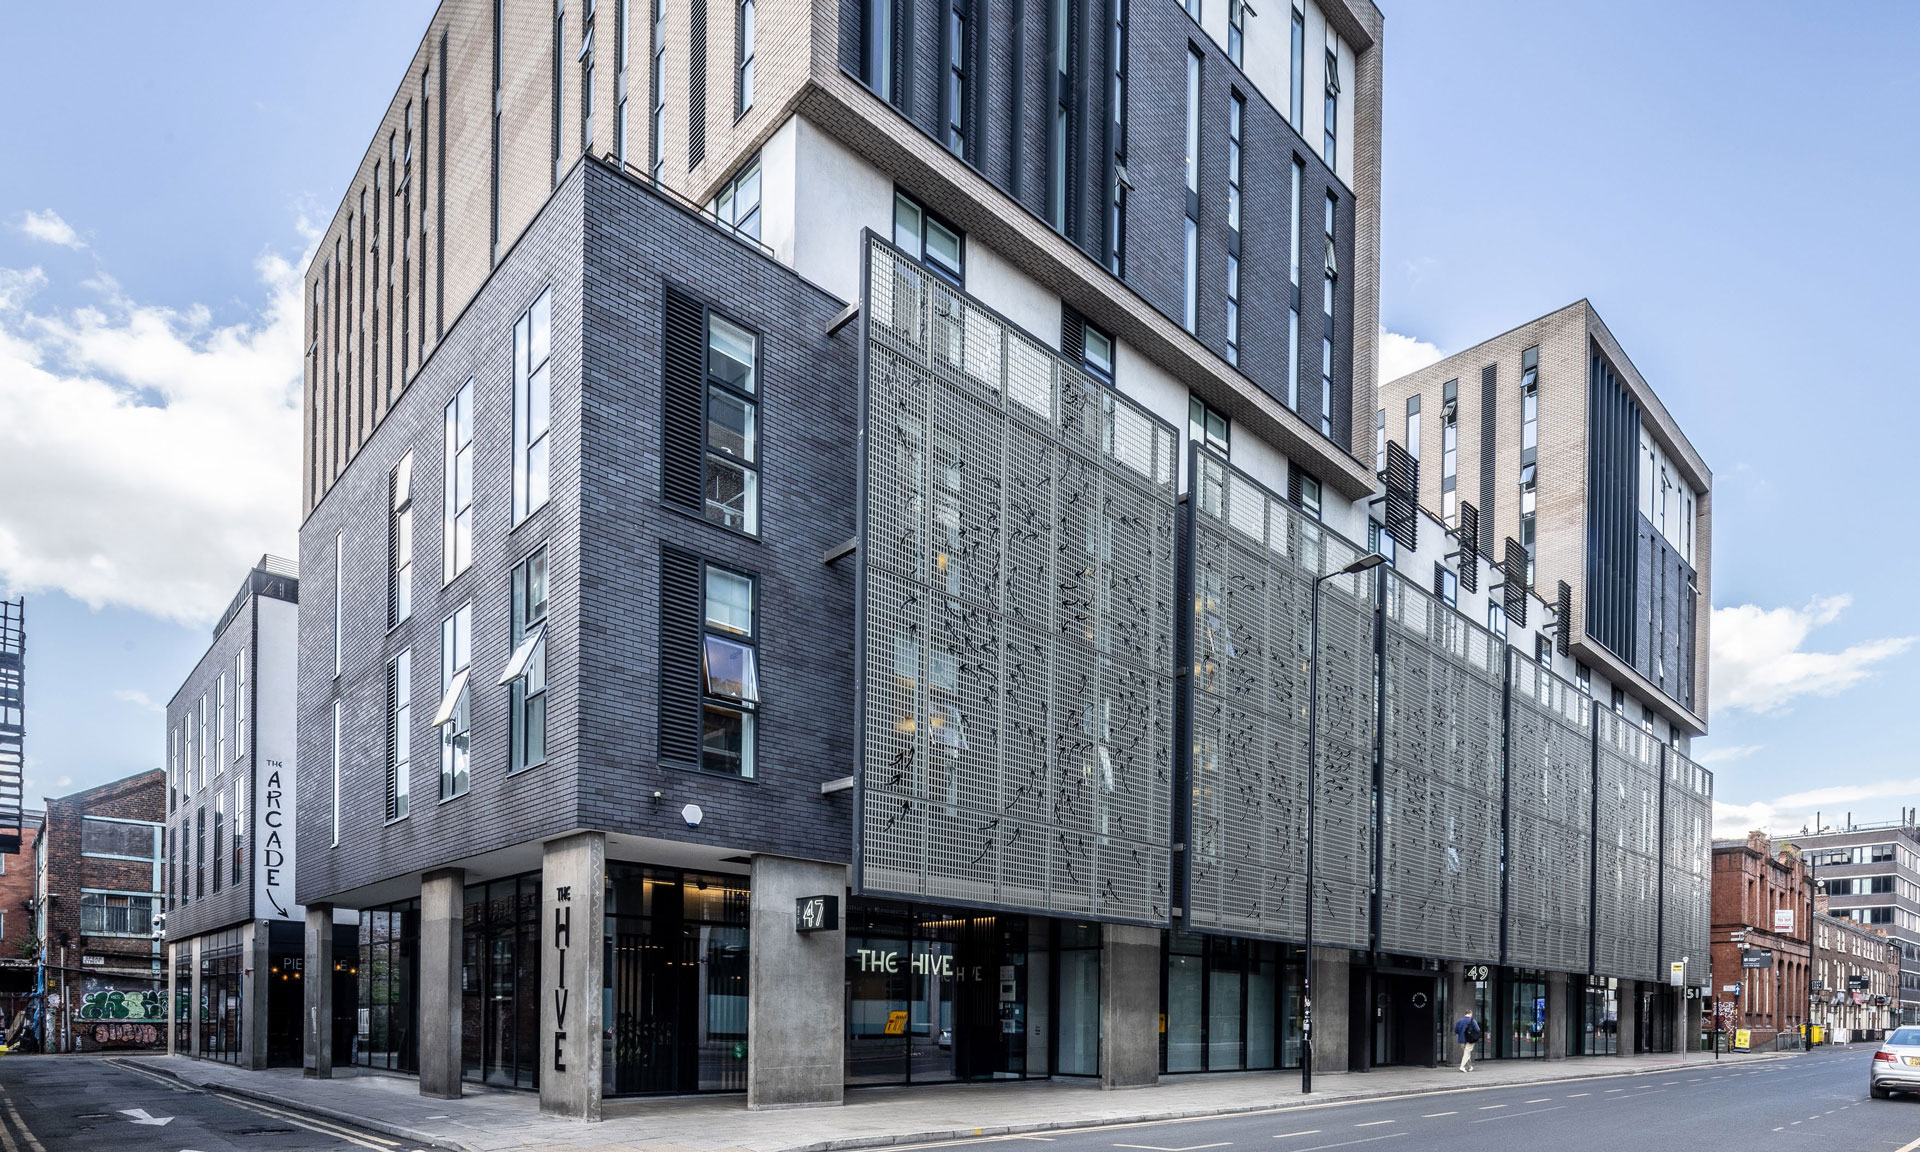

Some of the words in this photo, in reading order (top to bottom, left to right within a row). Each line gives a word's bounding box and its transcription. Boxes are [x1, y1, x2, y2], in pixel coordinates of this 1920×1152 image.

[266, 759, 283, 768] THE
[263, 770, 284, 887] ARCADE
[556, 886, 571, 902] THE
[803, 899, 824, 928] 47
[283, 957, 303, 970] PIE
[857, 949, 899, 973] THE
[911, 952, 954, 976] HIVE
[1468, 966, 1488, 980] 49
[554, 906, 571, 1072] HIVE
[1686, 988, 1700, 999] 51
